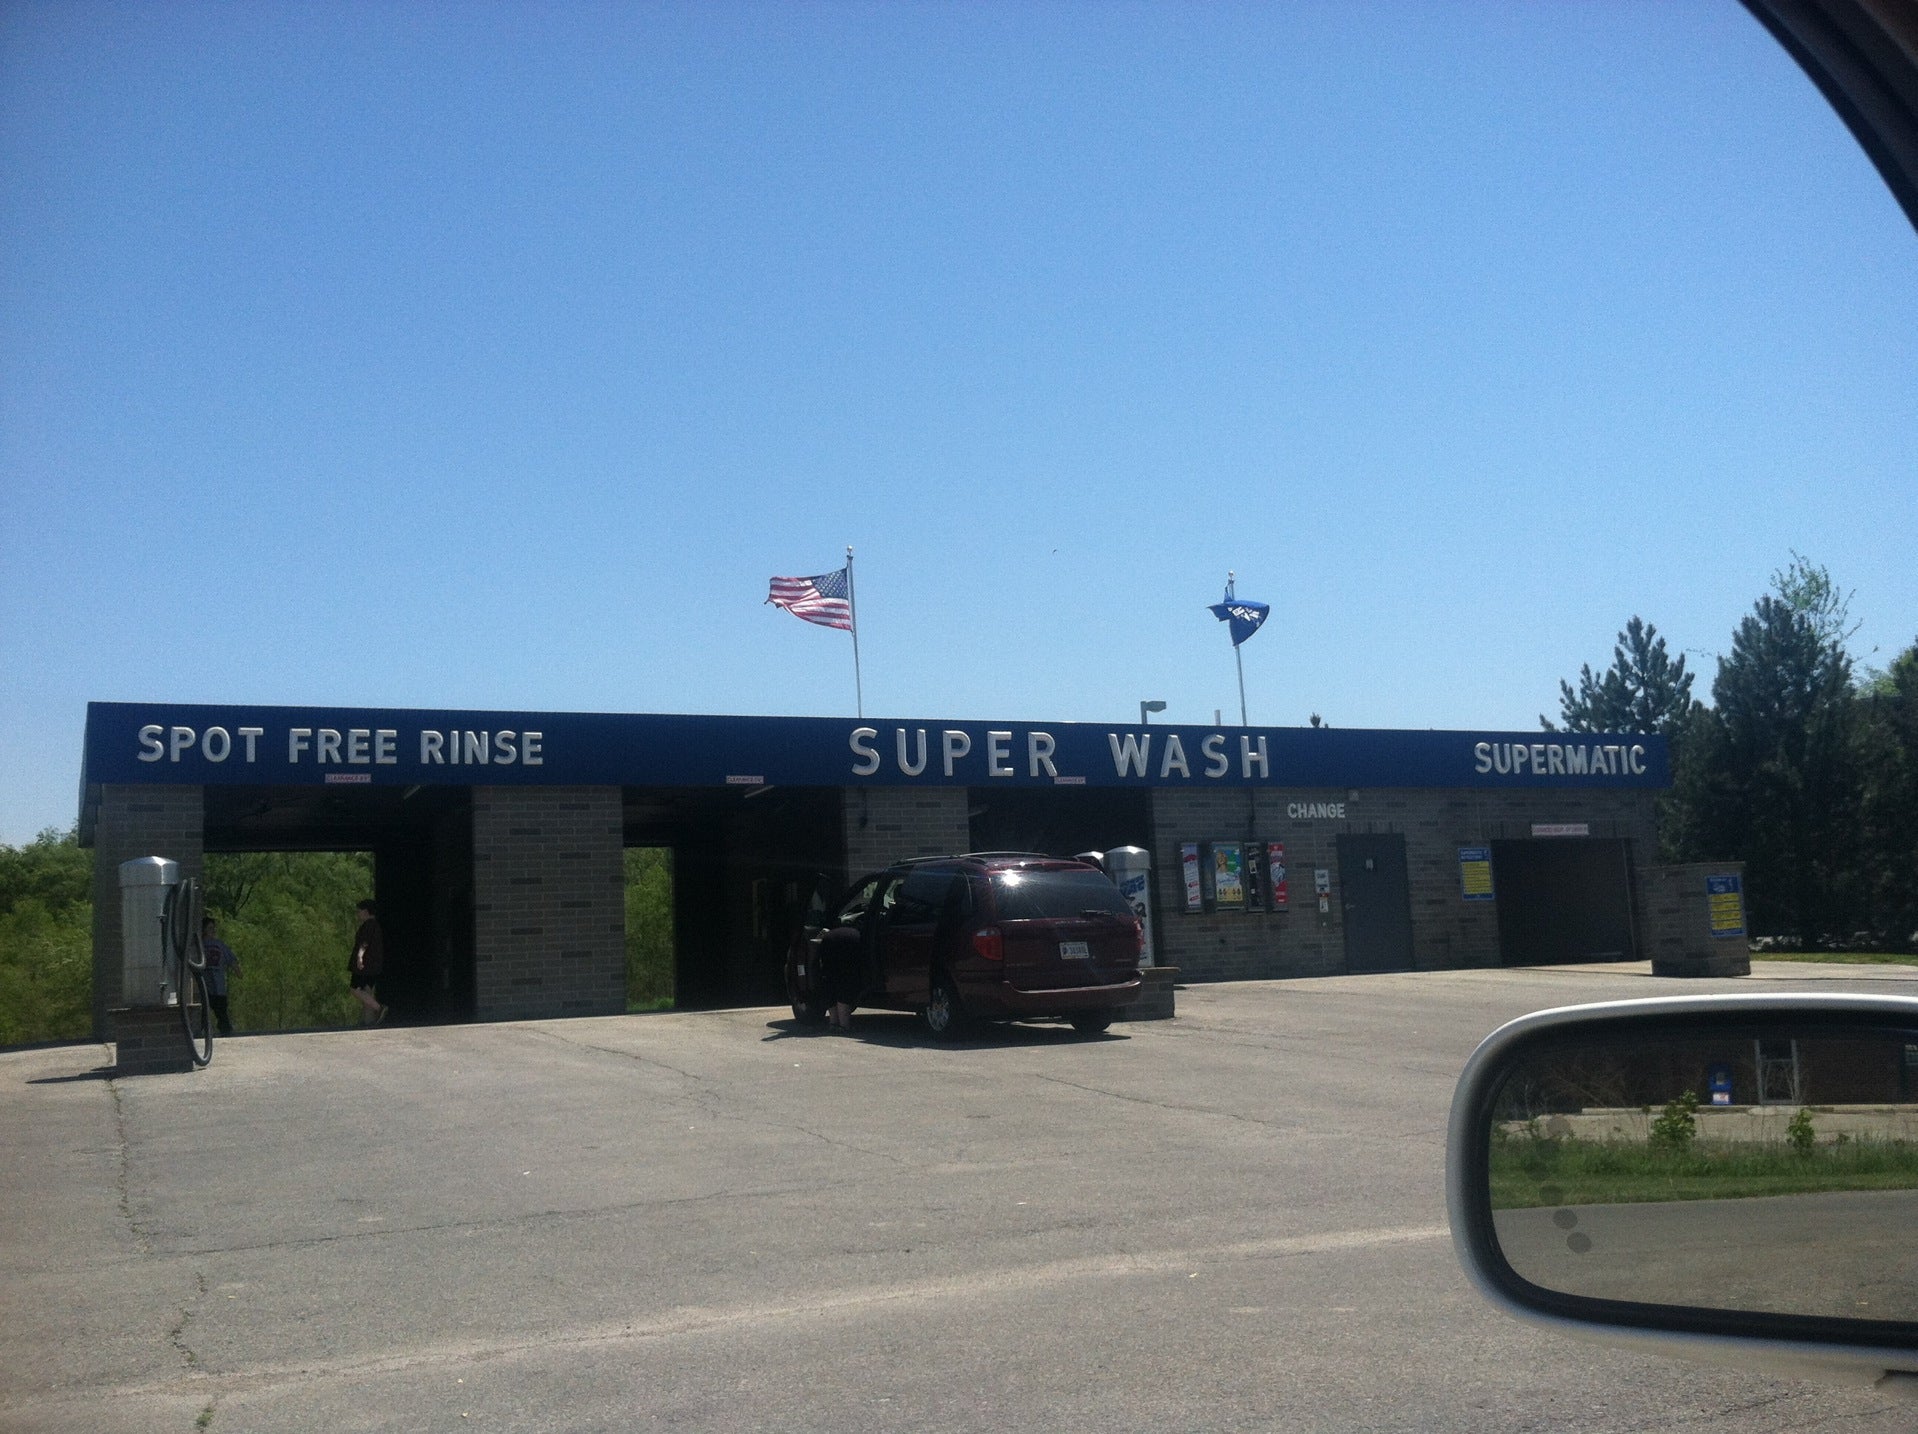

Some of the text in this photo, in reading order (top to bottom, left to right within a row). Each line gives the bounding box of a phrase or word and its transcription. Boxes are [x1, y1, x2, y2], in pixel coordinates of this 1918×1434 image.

[137, 724, 543, 765] SPOT FREE RINSE
[848, 727, 1270, 778] SUPER WASH
[1474, 742, 1647, 775] SUPERMATIC
[1287, 803, 1346, 819] CHANGE
